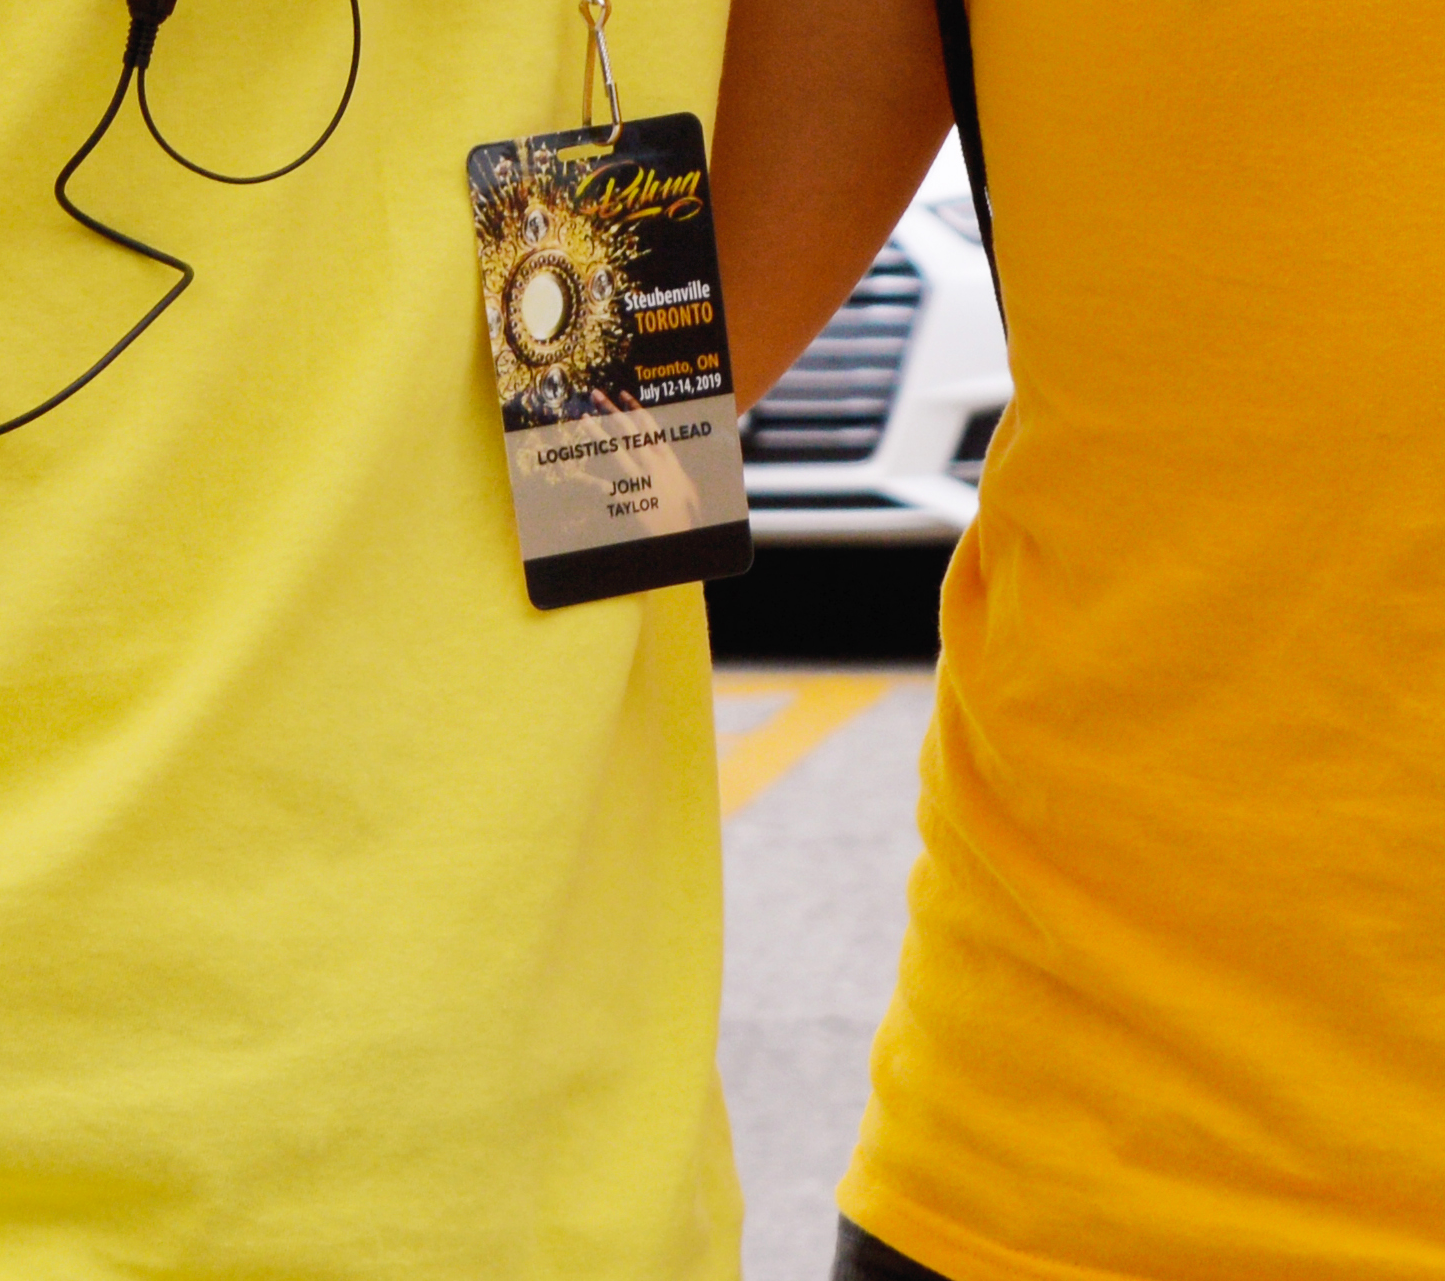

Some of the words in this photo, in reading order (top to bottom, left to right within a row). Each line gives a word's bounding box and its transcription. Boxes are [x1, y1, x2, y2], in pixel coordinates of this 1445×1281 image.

[624, 280, 711, 313] Steubenville
[635, 303, 714, 335] TORONTO
[635, 358, 692, 382] Toronto,
[697, 352, 720, 372] ON
[639, 380, 660, 404] July
[662, 378, 695, 399] 12-14,
[697, 372, 722, 393] 2019
[537, 439, 618, 465] LOGISTICS
[624, 431, 667, 452] TEAM
[670, 421, 712, 442] LEAD
[610, 476, 652, 496] JOHN
[607, 496, 659, 518] TAYLOR
